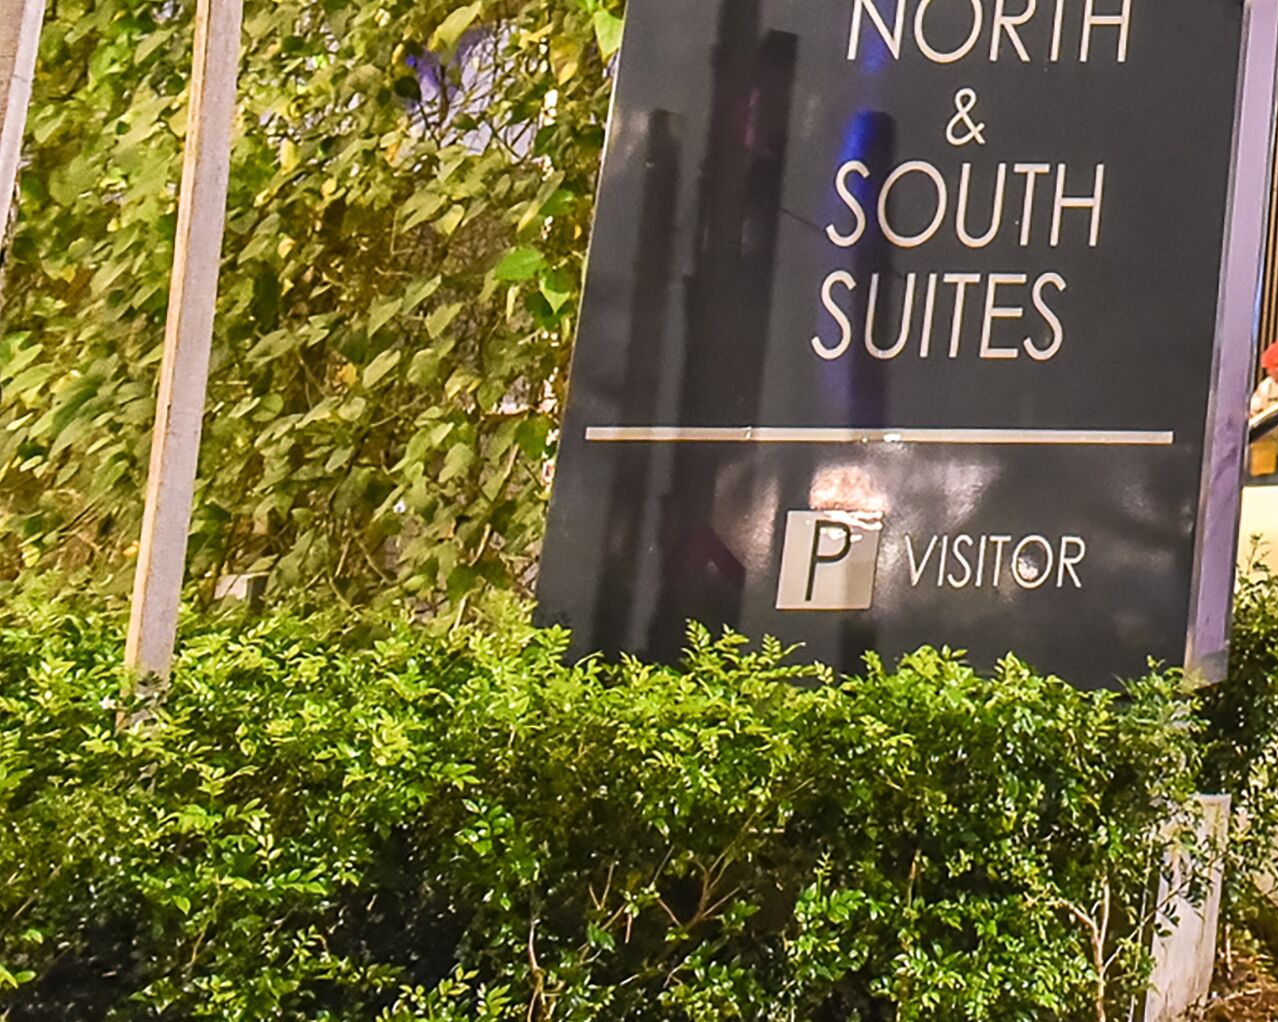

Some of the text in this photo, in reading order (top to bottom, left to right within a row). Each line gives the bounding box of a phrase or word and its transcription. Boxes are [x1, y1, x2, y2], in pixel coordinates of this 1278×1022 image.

[847, 0, 1132, 63] NORTH
[945, 87, 986, 146] &
[825, 160, 1105, 248] SOUTH
[810, 270, 1067, 360] SUITES
[804, 519, 1086, 602] P VISITOR
